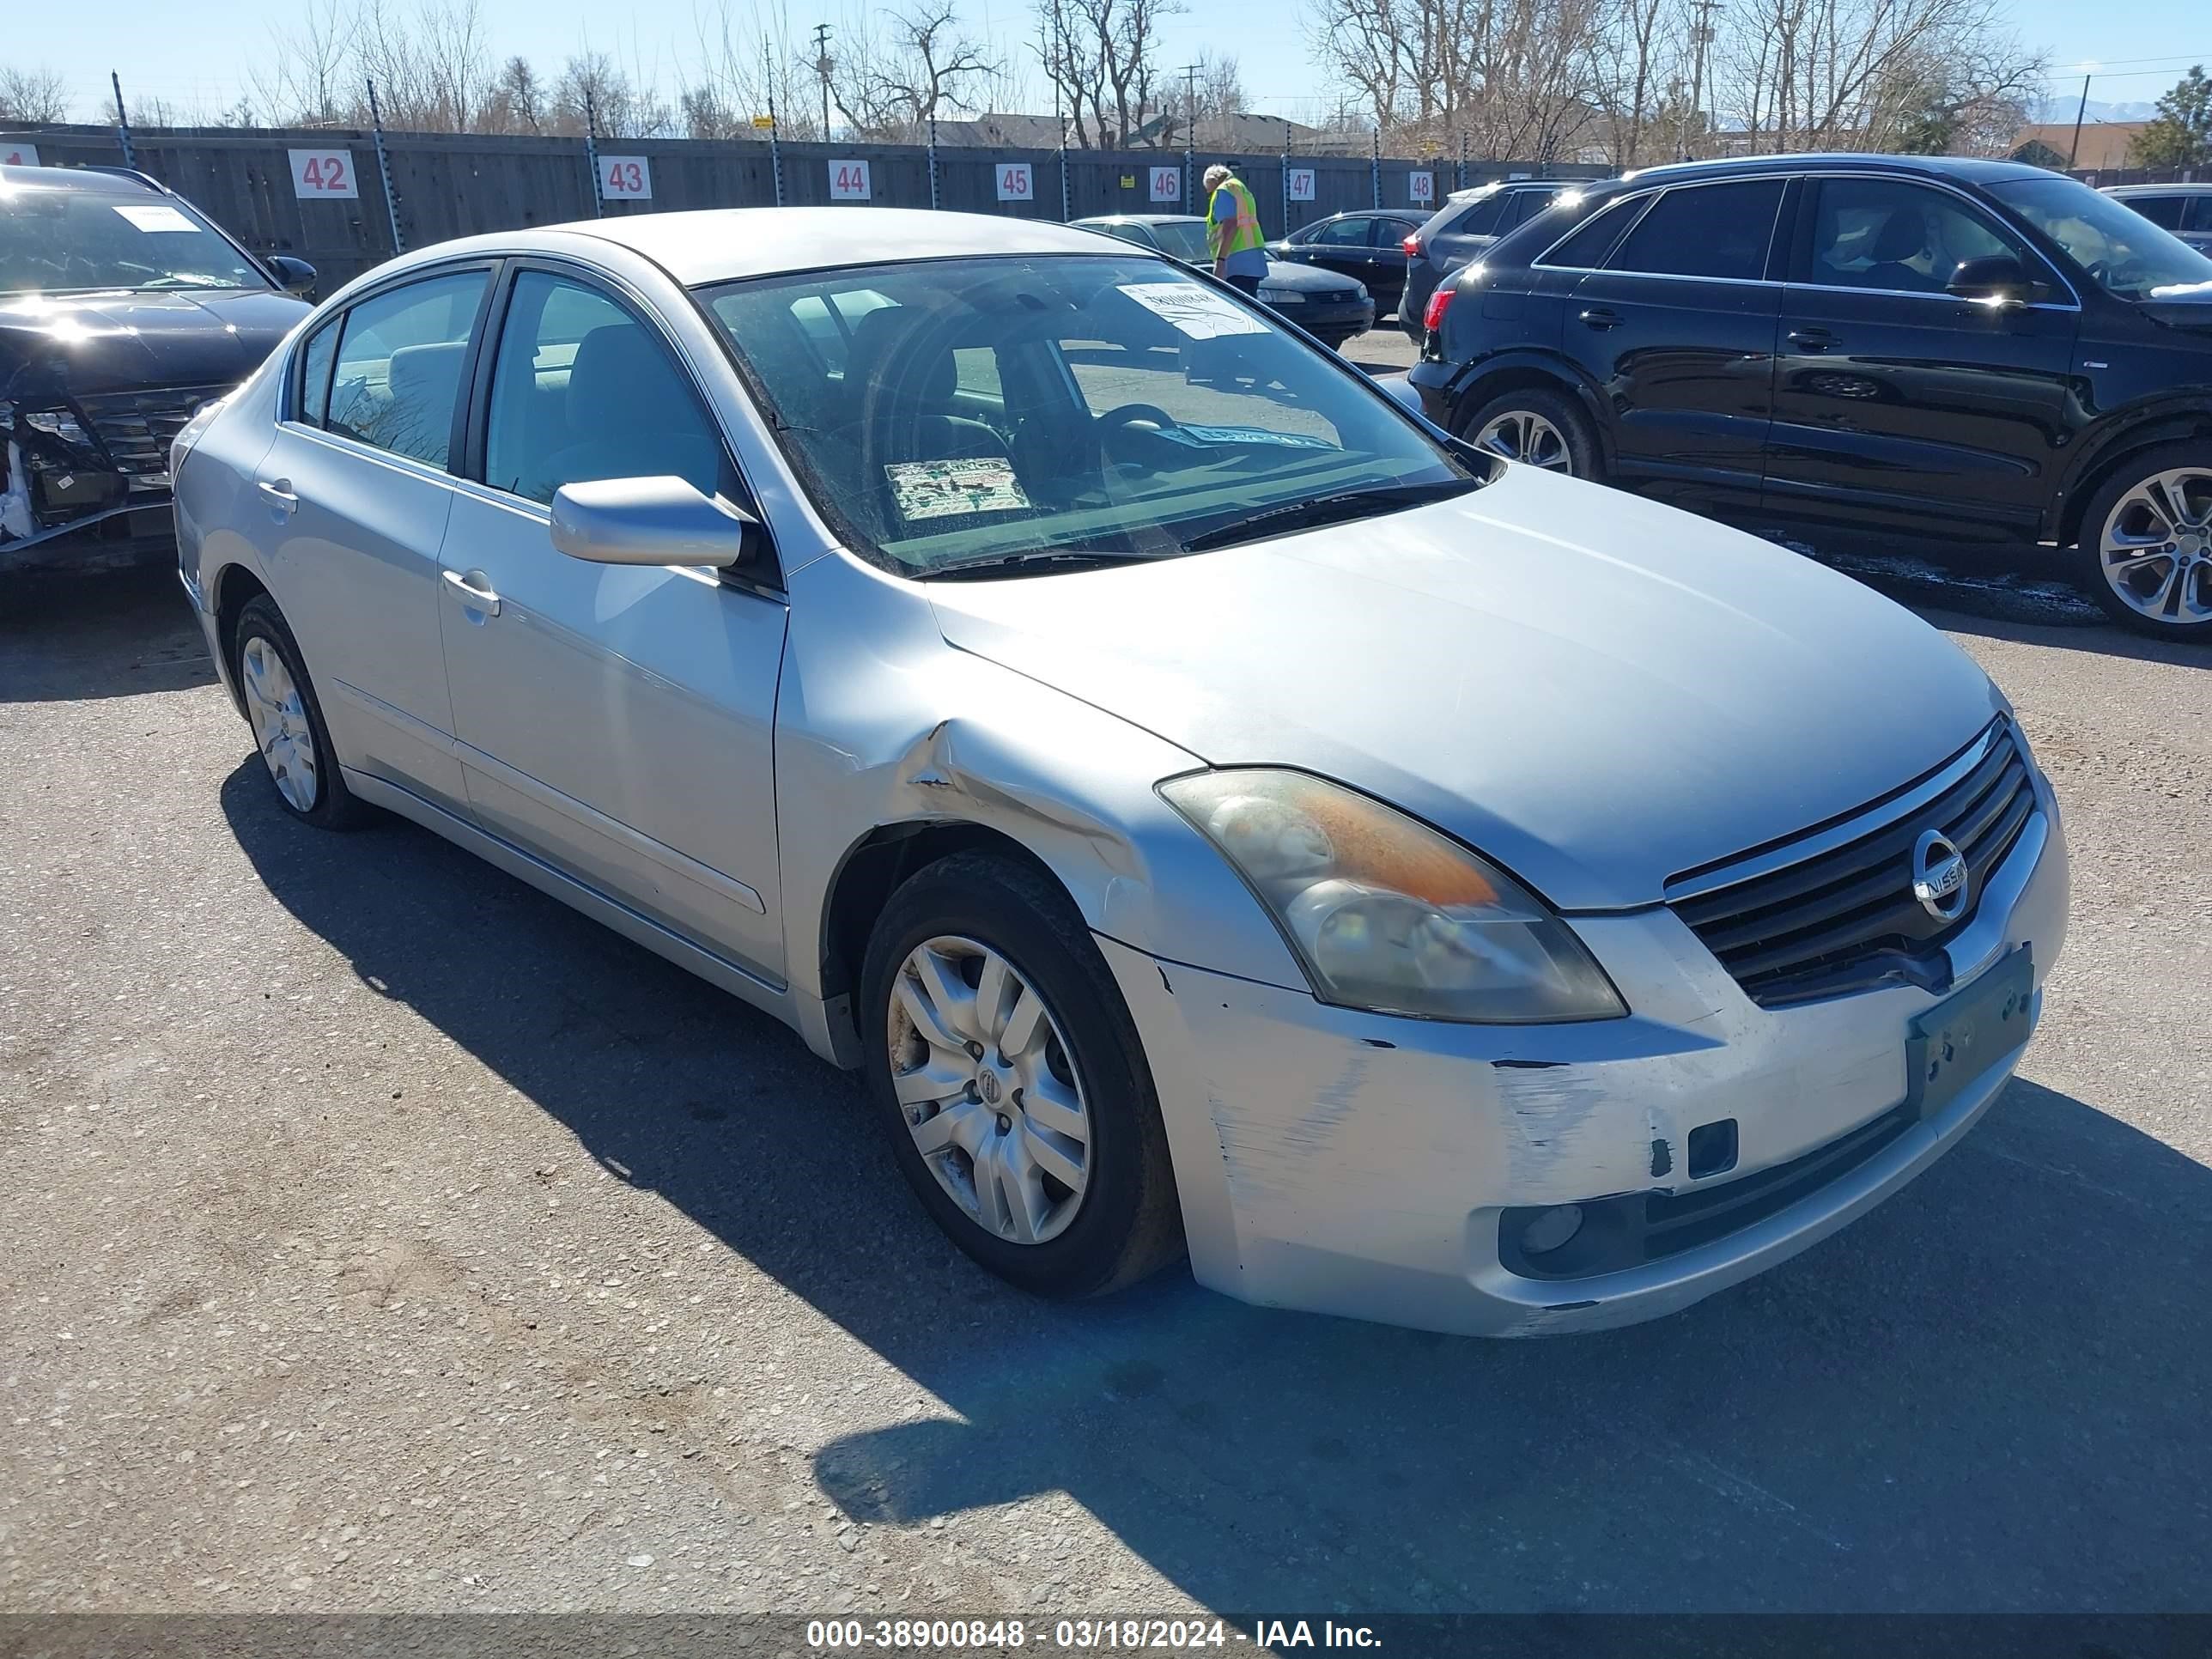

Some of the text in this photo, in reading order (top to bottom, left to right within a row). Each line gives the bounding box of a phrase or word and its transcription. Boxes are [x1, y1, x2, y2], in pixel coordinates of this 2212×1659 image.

[303, 157, 348, 190] 42
[610, 163, 643, 192] 43
[837, 167, 864, 192] 44
[1003, 170, 1027, 194] 45
[1155, 173, 1176, 196] 46
[1294, 174, 1311, 195] 47
[1414, 176, 1429, 196] 48
